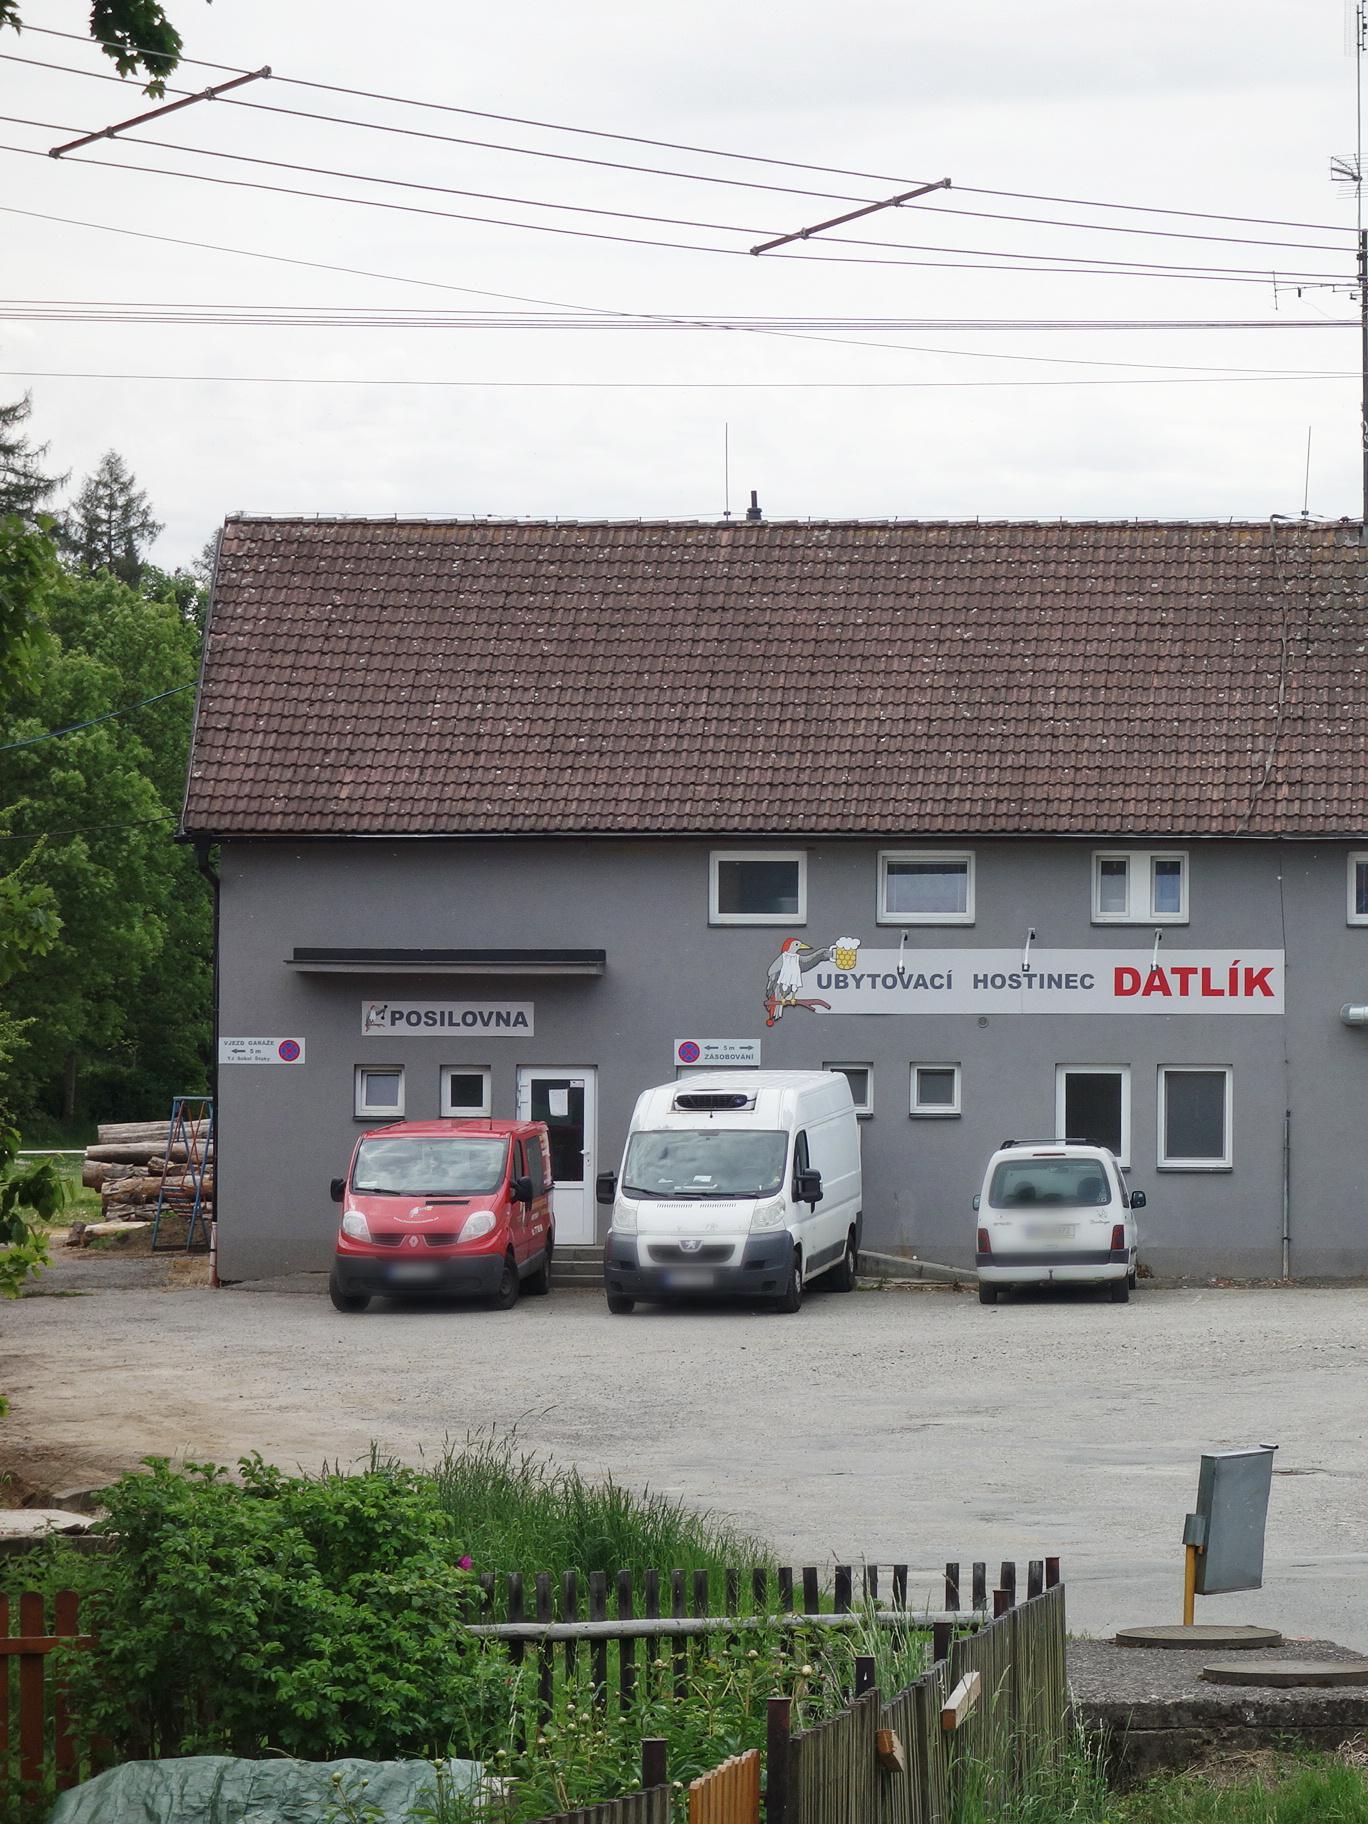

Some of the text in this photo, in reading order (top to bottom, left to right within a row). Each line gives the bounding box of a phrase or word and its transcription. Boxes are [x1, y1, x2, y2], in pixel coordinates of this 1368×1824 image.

[816, 959, 1275, 997] UBYTOVACÍ HOSTINEC DATLÍK
[390, 1010, 529, 1028] POSILOVNA
